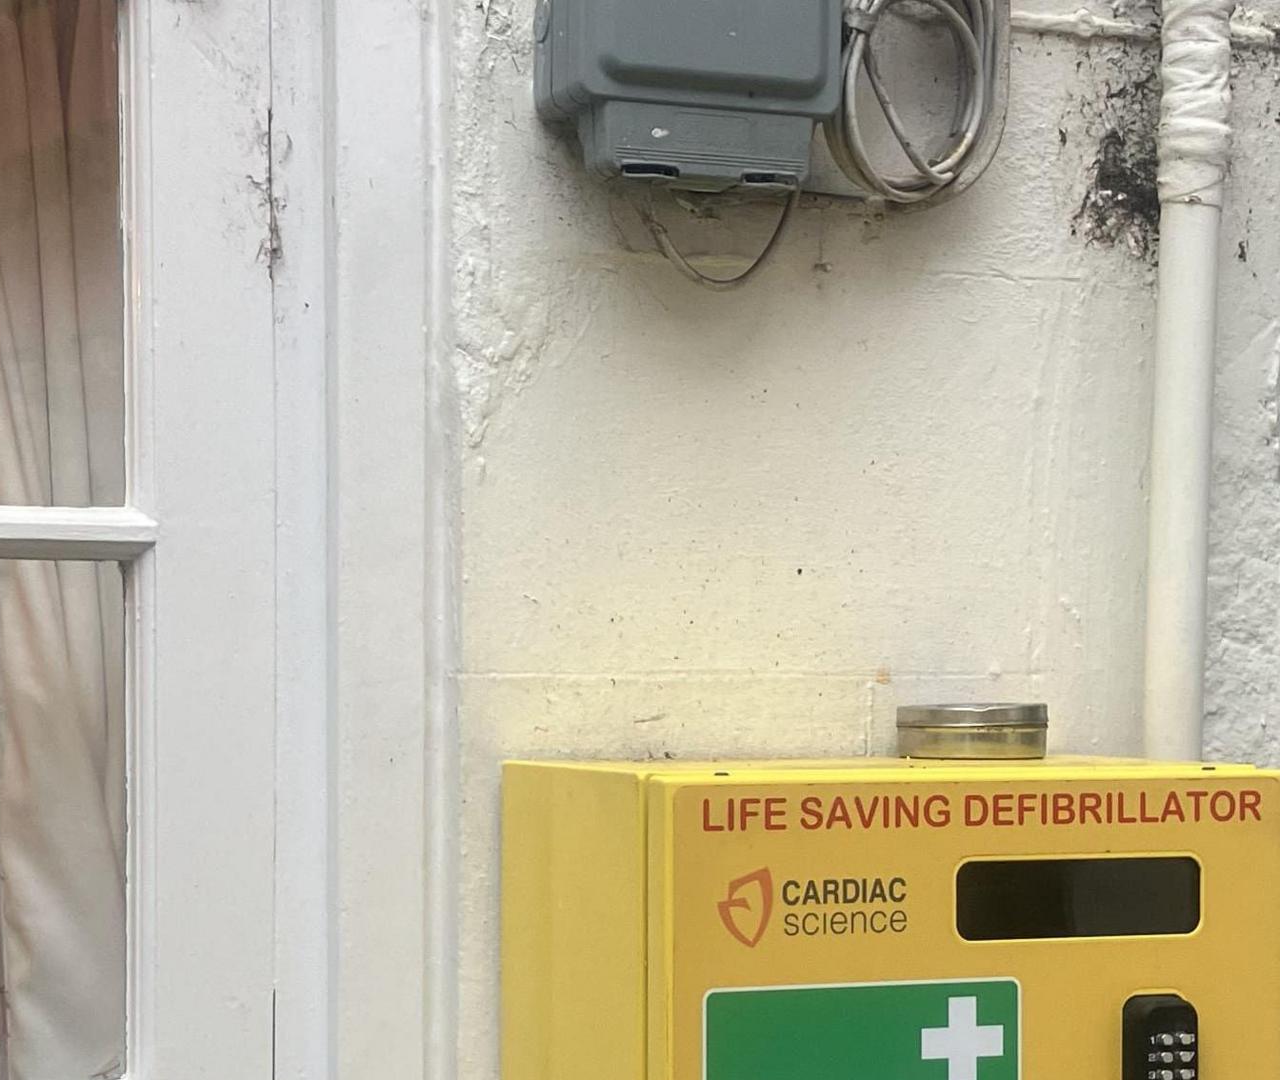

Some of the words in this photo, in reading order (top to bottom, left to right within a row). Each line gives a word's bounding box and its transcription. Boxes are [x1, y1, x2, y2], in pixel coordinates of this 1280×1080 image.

[702, 797, 788, 832] LIFE
[799, 794, 952, 830] SAVING
[963, 790, 1262, 827] DEFIBRILLATOR
[781, 877, 907, 906] CARDIAC
[783, 909, 908, 936] science
